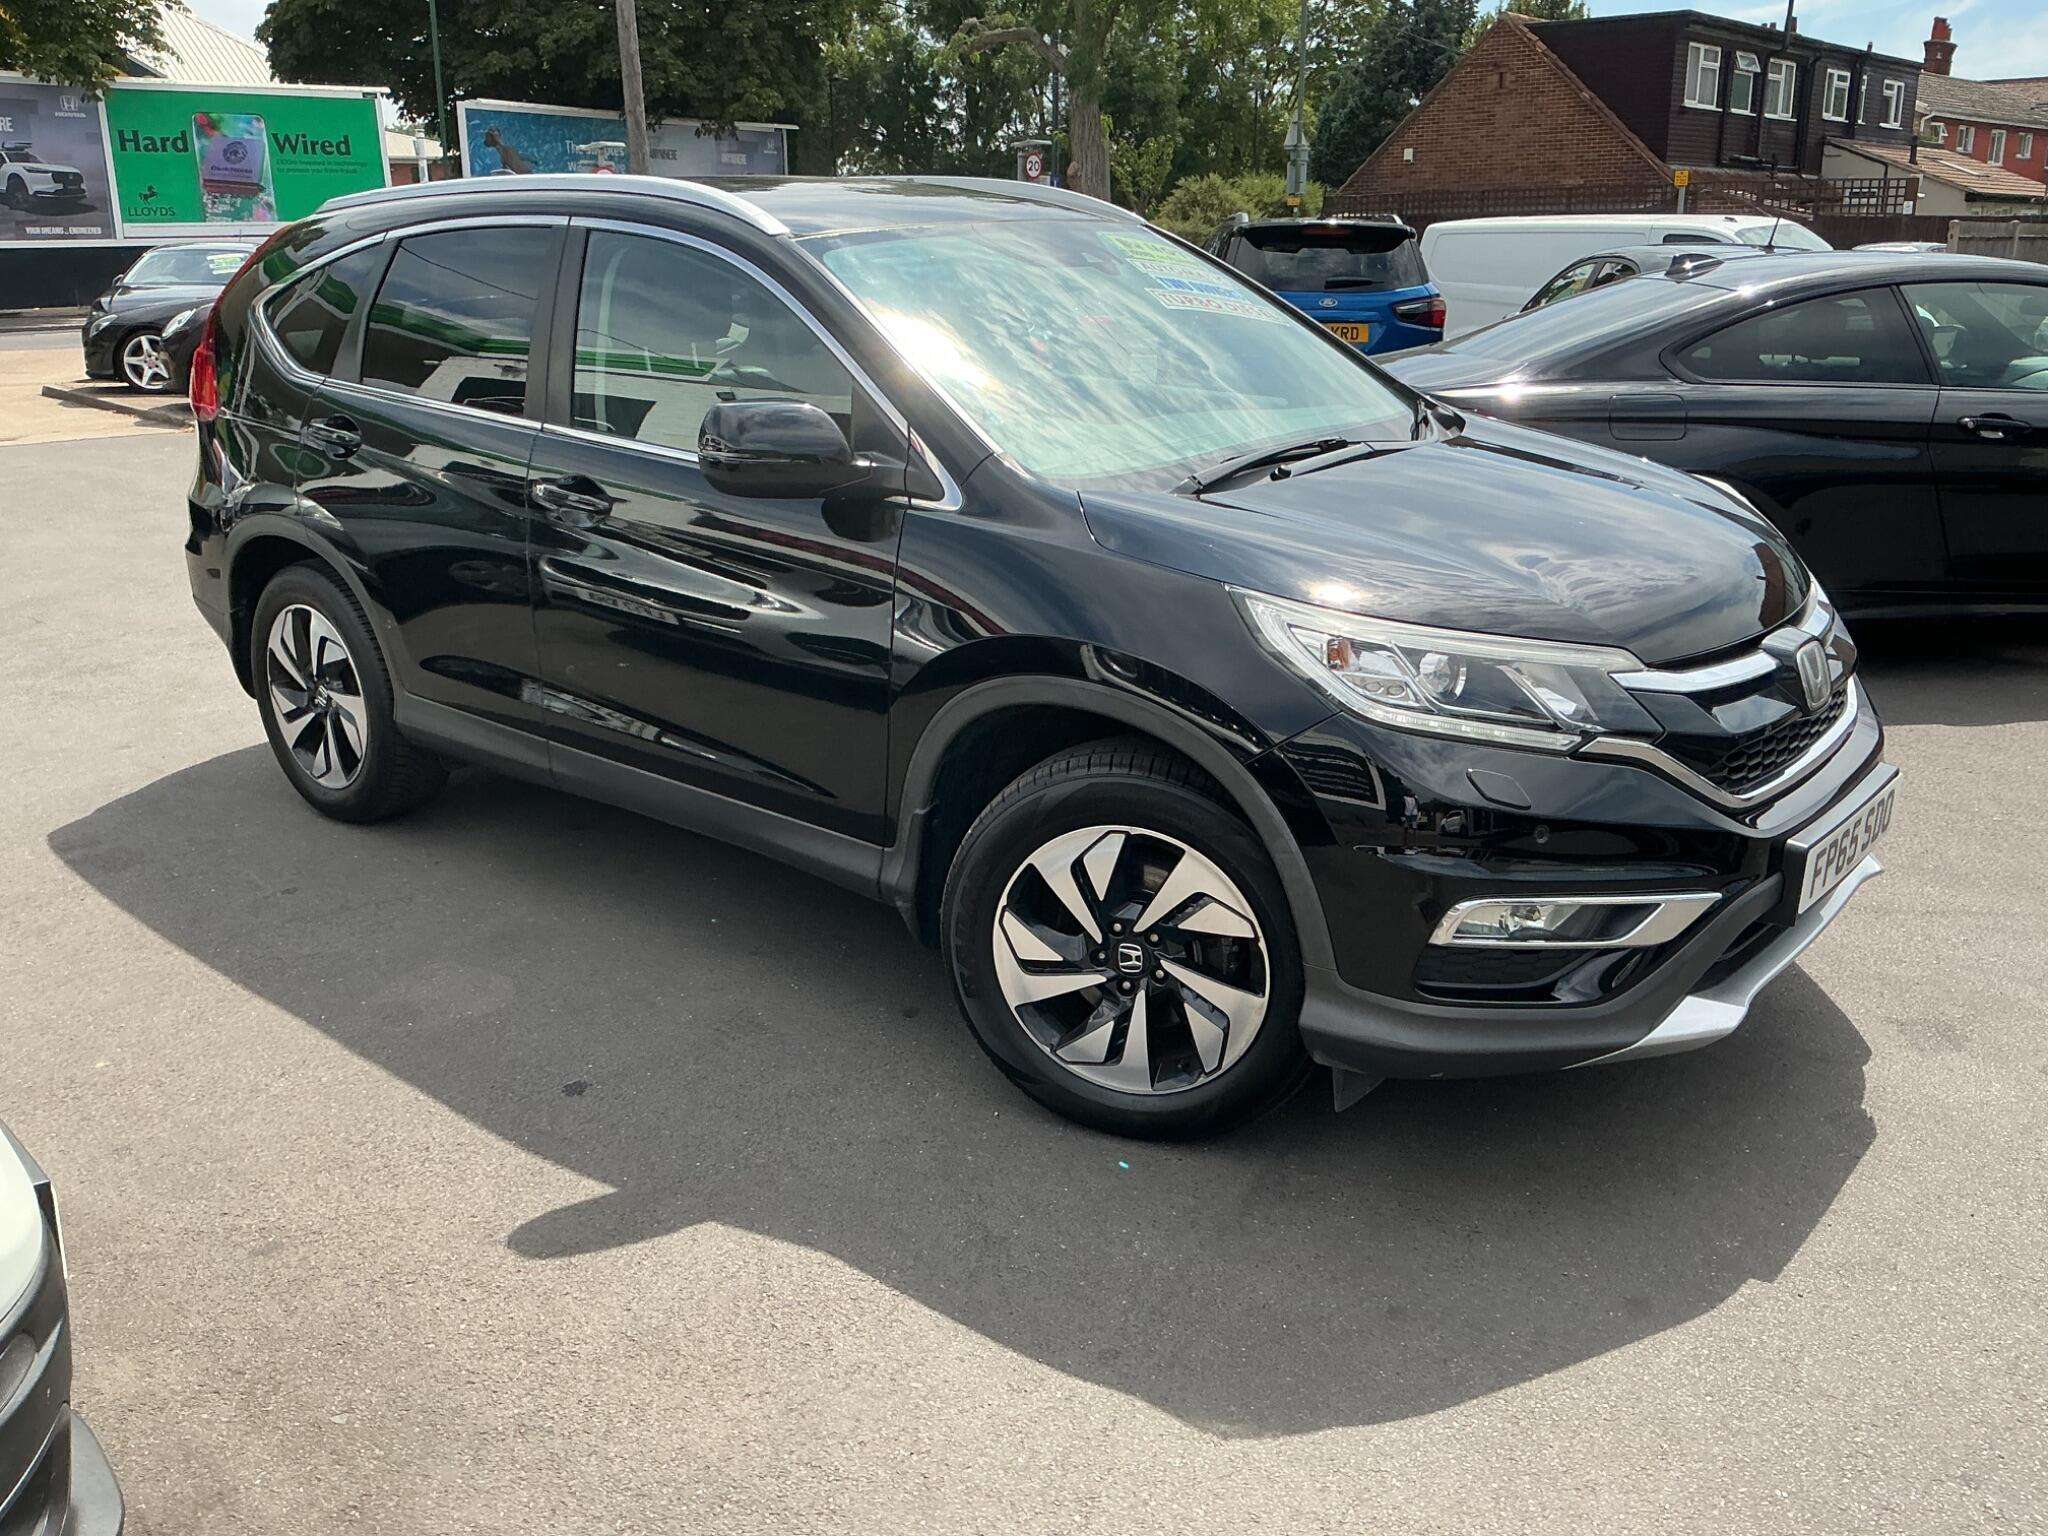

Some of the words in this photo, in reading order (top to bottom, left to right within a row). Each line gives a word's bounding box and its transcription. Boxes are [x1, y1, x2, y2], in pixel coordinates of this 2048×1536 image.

[117, 129, 190, 153] Hard
[271, 132, 352, 156] Wired
[1028, 160, 1040, 172] 20
[127, 206, 176, 217] LLOYDS
[1809, 817, 1862, 899] FP65
